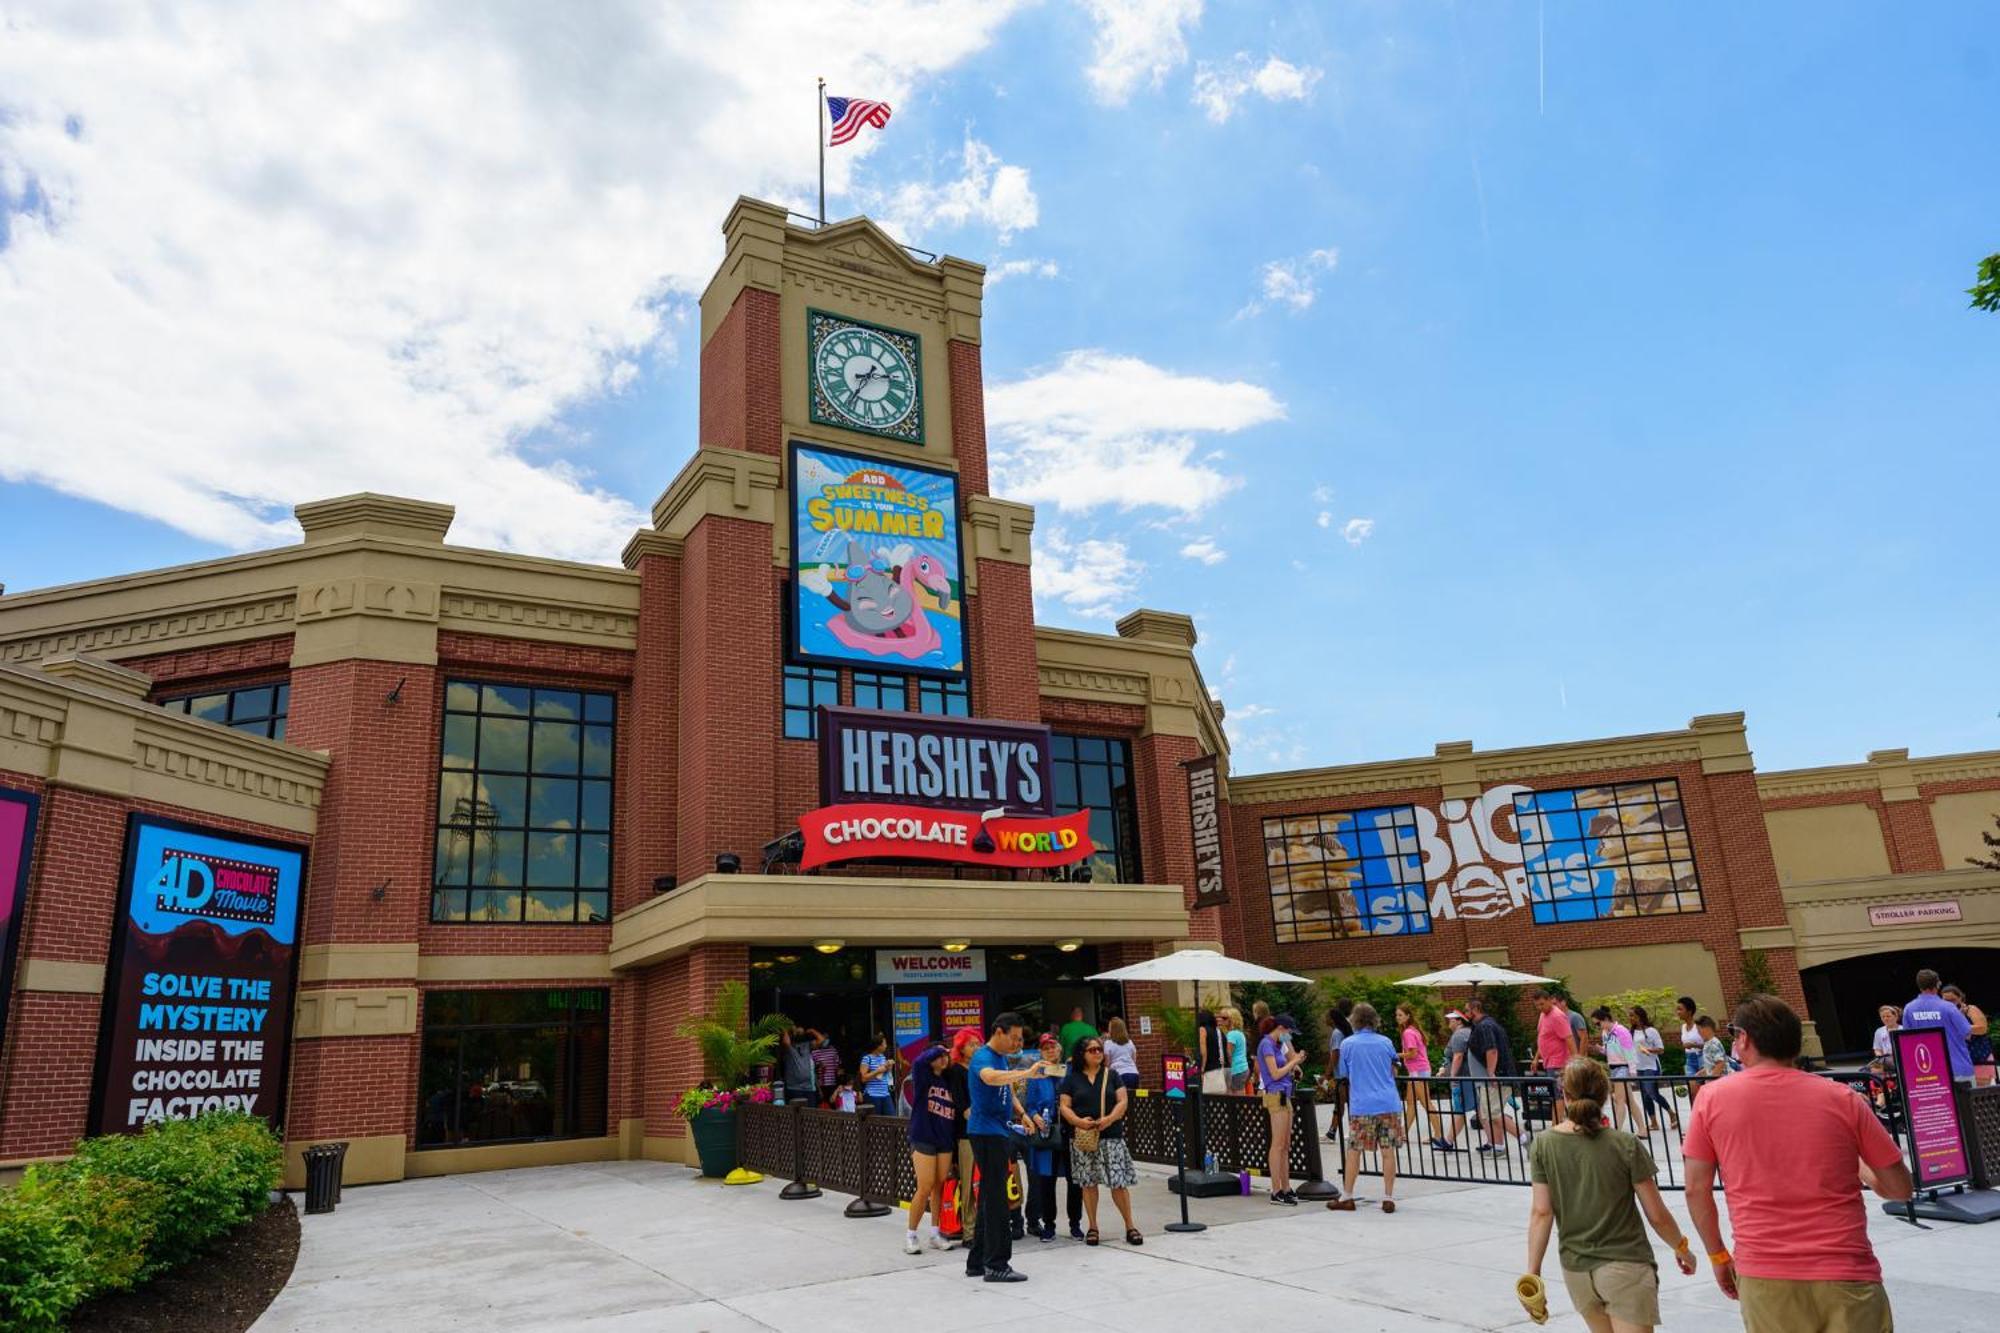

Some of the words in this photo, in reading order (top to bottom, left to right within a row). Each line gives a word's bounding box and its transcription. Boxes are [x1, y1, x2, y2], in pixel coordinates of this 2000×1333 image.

[863, 473, 885, 484] ADD
[822, 485, 929, 511] SWEETNESS
[861, 501, 872, 509] TO
[874, 502, 894, 511] YOUR
[807, 498, 945, 539] SUMMER
[841, 728, 1042, 803] HERSHEY'S
[823, 817, 968, 846] CHOCOLATE
[997, 828, 1079, 853] WORLD
[1190, 767, 1223, 894] HERSHEY'S
[148, 856, 215, 909] 4D
[215, 868, 273, 896] CHOCOLATE
[214, 888, 269, 913] Movie
[1875, 911, 1915, 919] STROLLER
[1918, 907, 1955, 916] PARKING
[892, 956, 972, 970] WELCOME
[142, 972, 223, 999] SOLVE
[228, 978, 272, 1000] THE
[945, 1000, 979, 1008] TICKETS
[138, 1003, 268, 1032] MYSTERY
[946, 1016, 980, 1025] ONLINE
[135, 1039, 216, 1062] INSIDE
[221, 1040, 265, 1061] THE
[1166, 1060, 1183, 1070] EXIT
[1166, 1071, 1184, 1080] ONLY
[132, 1069, 262, 1091] CHOCOLATE
